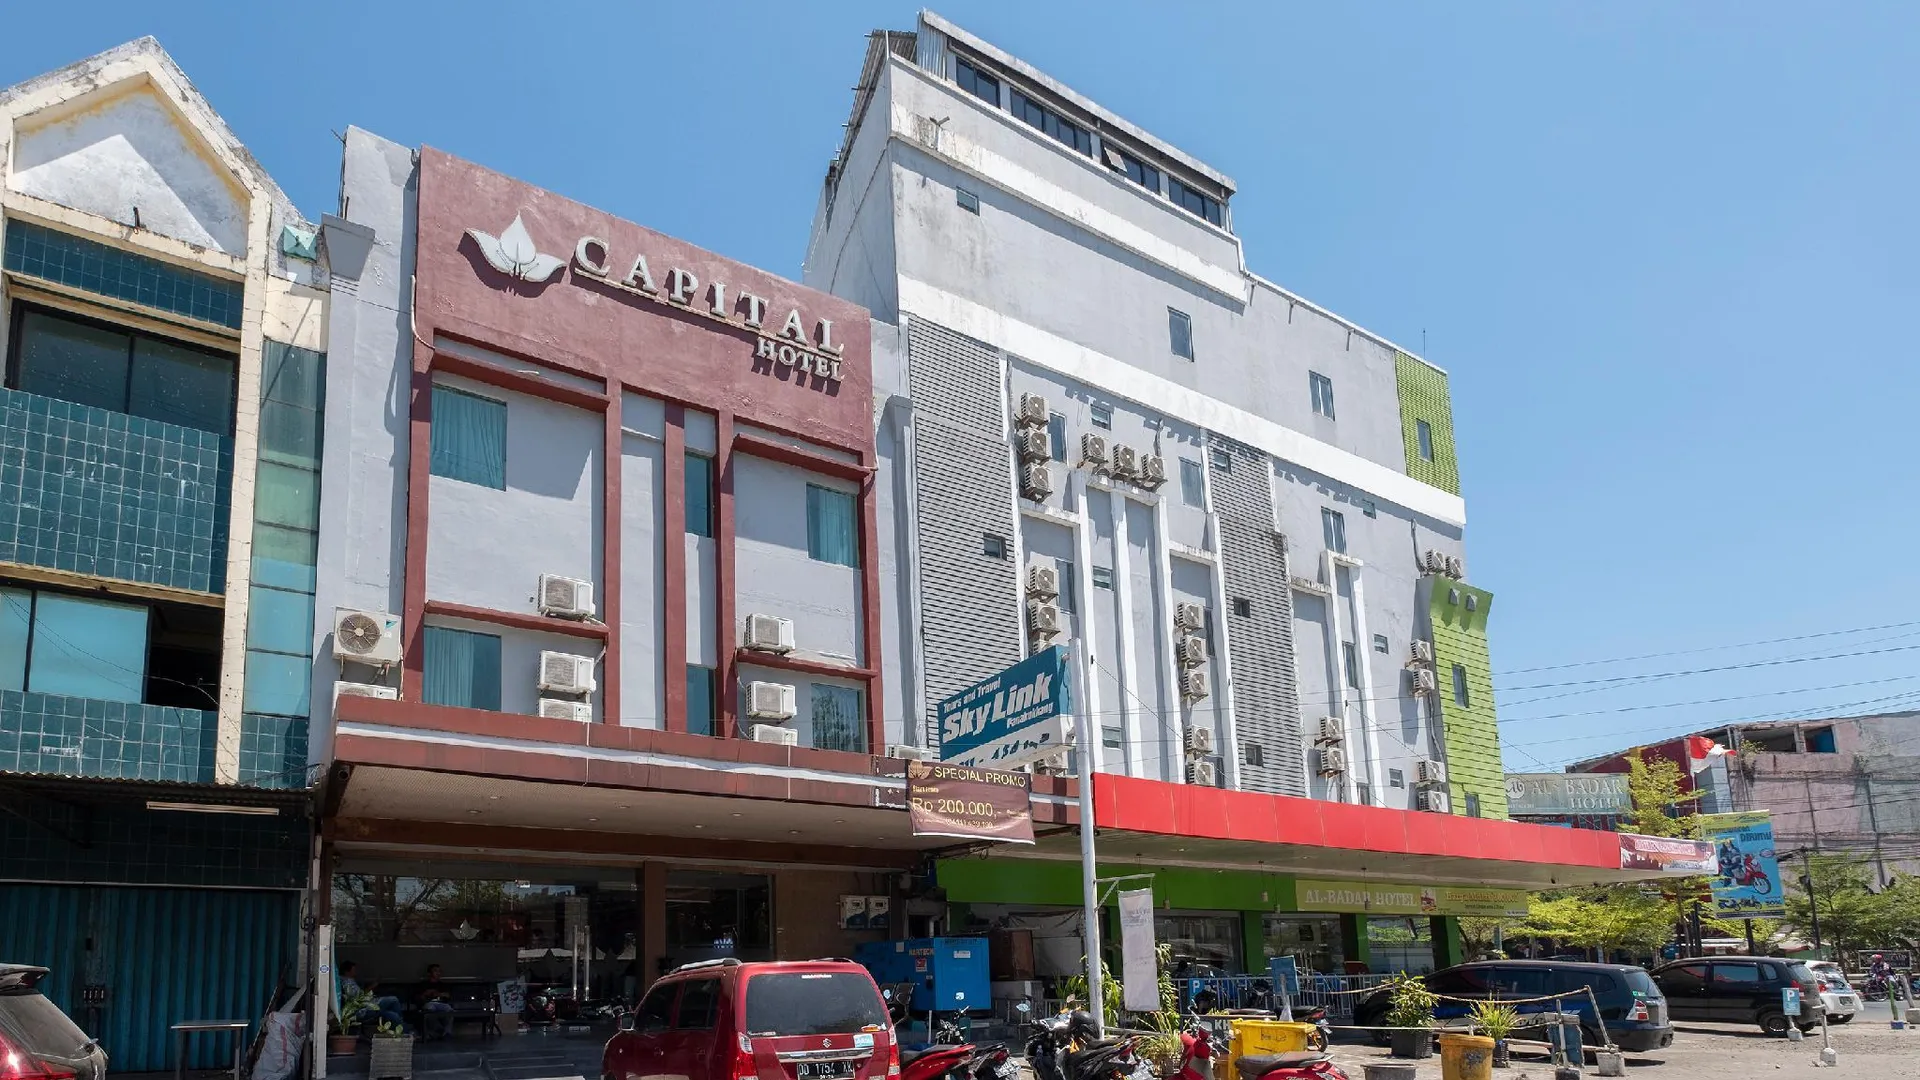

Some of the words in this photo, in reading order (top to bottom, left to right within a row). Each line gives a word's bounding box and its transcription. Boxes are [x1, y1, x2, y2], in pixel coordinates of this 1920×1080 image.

[575, 235, 844, 355] CAPITAL
[756, 336, 844, 383] HOTEL
[934, 766, 984, 782] SPECIAL
[985, 772, 1026, 787] PROMO
[912, 796, 933, 814] Rp
[1375, 891, 1418, 907] HOTEL
[1193, 980, 1200, 993] P
[1787, 990, 1795, 1001] P
